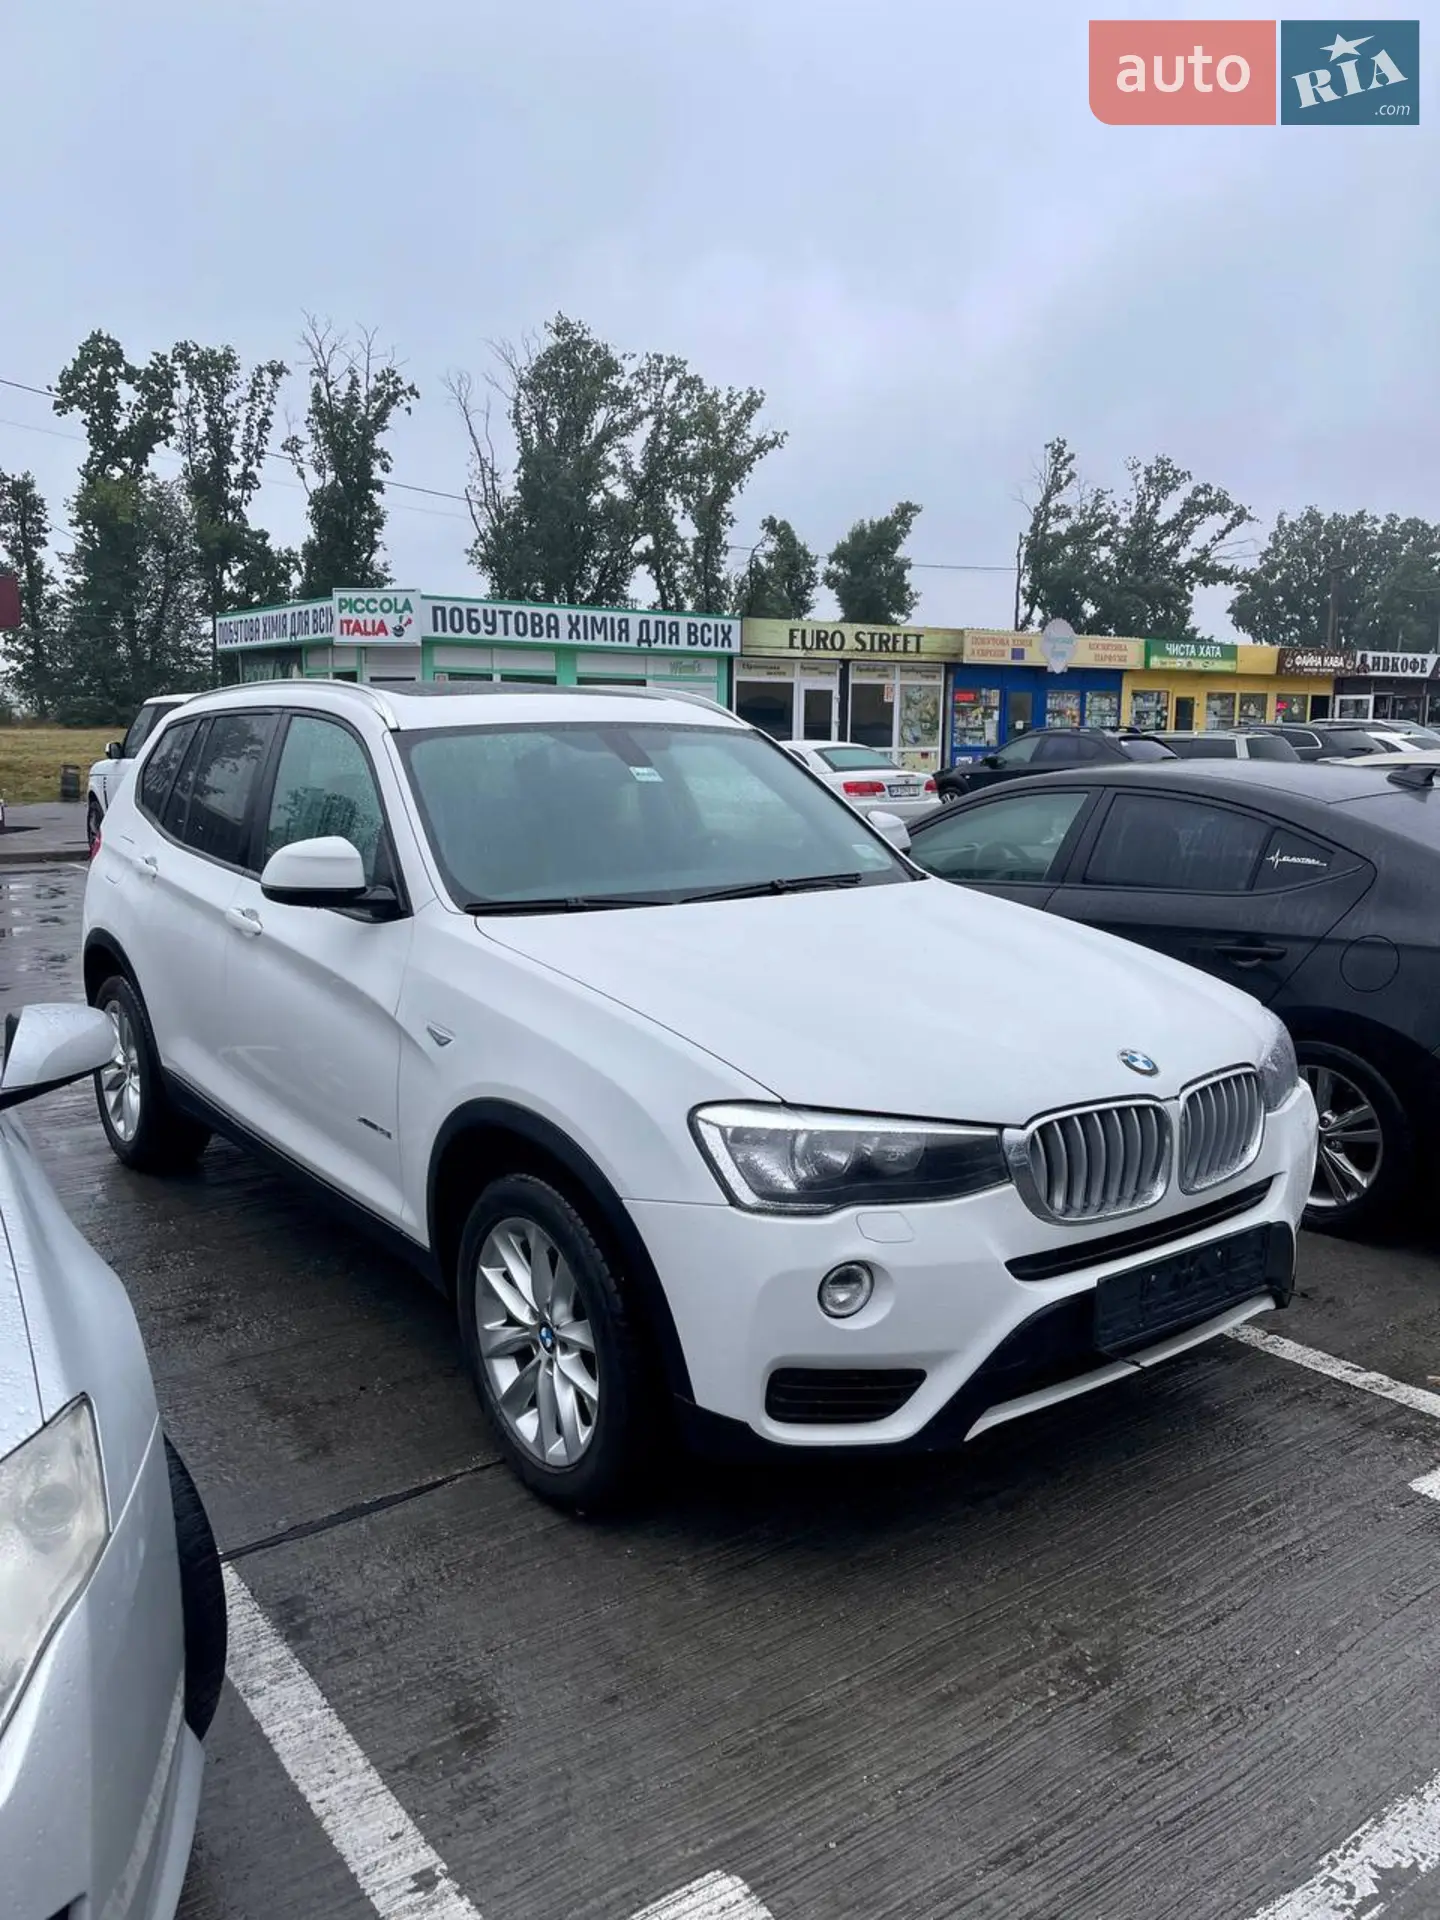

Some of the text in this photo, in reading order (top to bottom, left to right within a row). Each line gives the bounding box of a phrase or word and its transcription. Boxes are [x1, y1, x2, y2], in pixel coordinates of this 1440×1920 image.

[338, 597, 413, 614] PICCOLA
[218, 617, 260, 645] ПОБУТОВА
[262, 613, 288, 640] ХІМІЯ
[290, 608, 310, 642] ДЛЯ
[340, 619, 388, 636] ITALIA
[432, 605, 733, 648] ПОБУТОВА ХІМІЯ ДЛЯ ВСІХ
[788, 628, 925, 654] EURO STREET
[1165, 643, 1222, 658] ЧИСТА ХАТА
[1294, 653, 1345, 668] ФАЙНА КАВА
